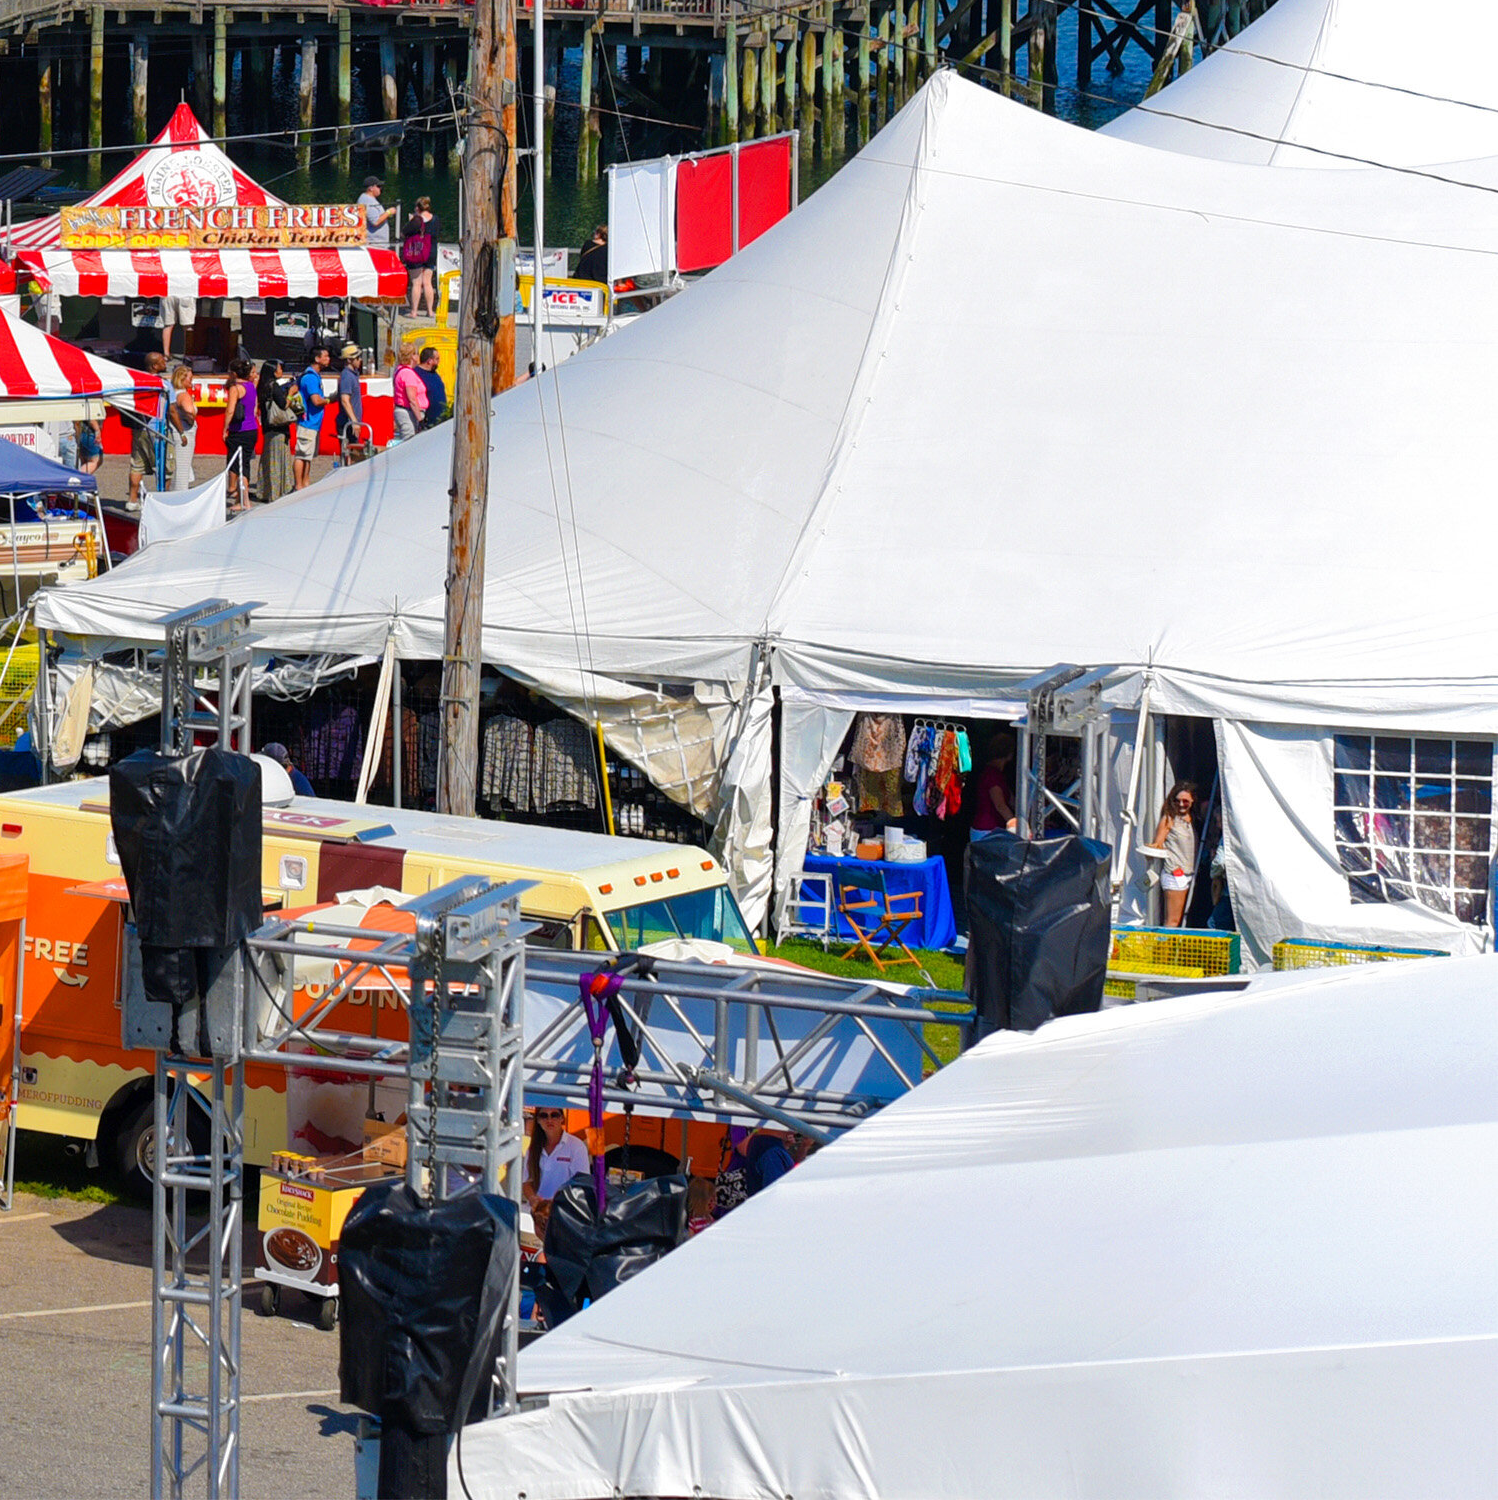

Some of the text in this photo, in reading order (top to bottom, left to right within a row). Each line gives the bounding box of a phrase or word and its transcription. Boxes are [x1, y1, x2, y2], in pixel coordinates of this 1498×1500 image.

[119, 204, 361, 230] FRENCH FRIES
[65, 233, 125, 247] CORN
[203, 230, 362, 245] Chicken Tenders
[551, 292, 578, 304] ICE
[24, 936, 89, 966] FREE
